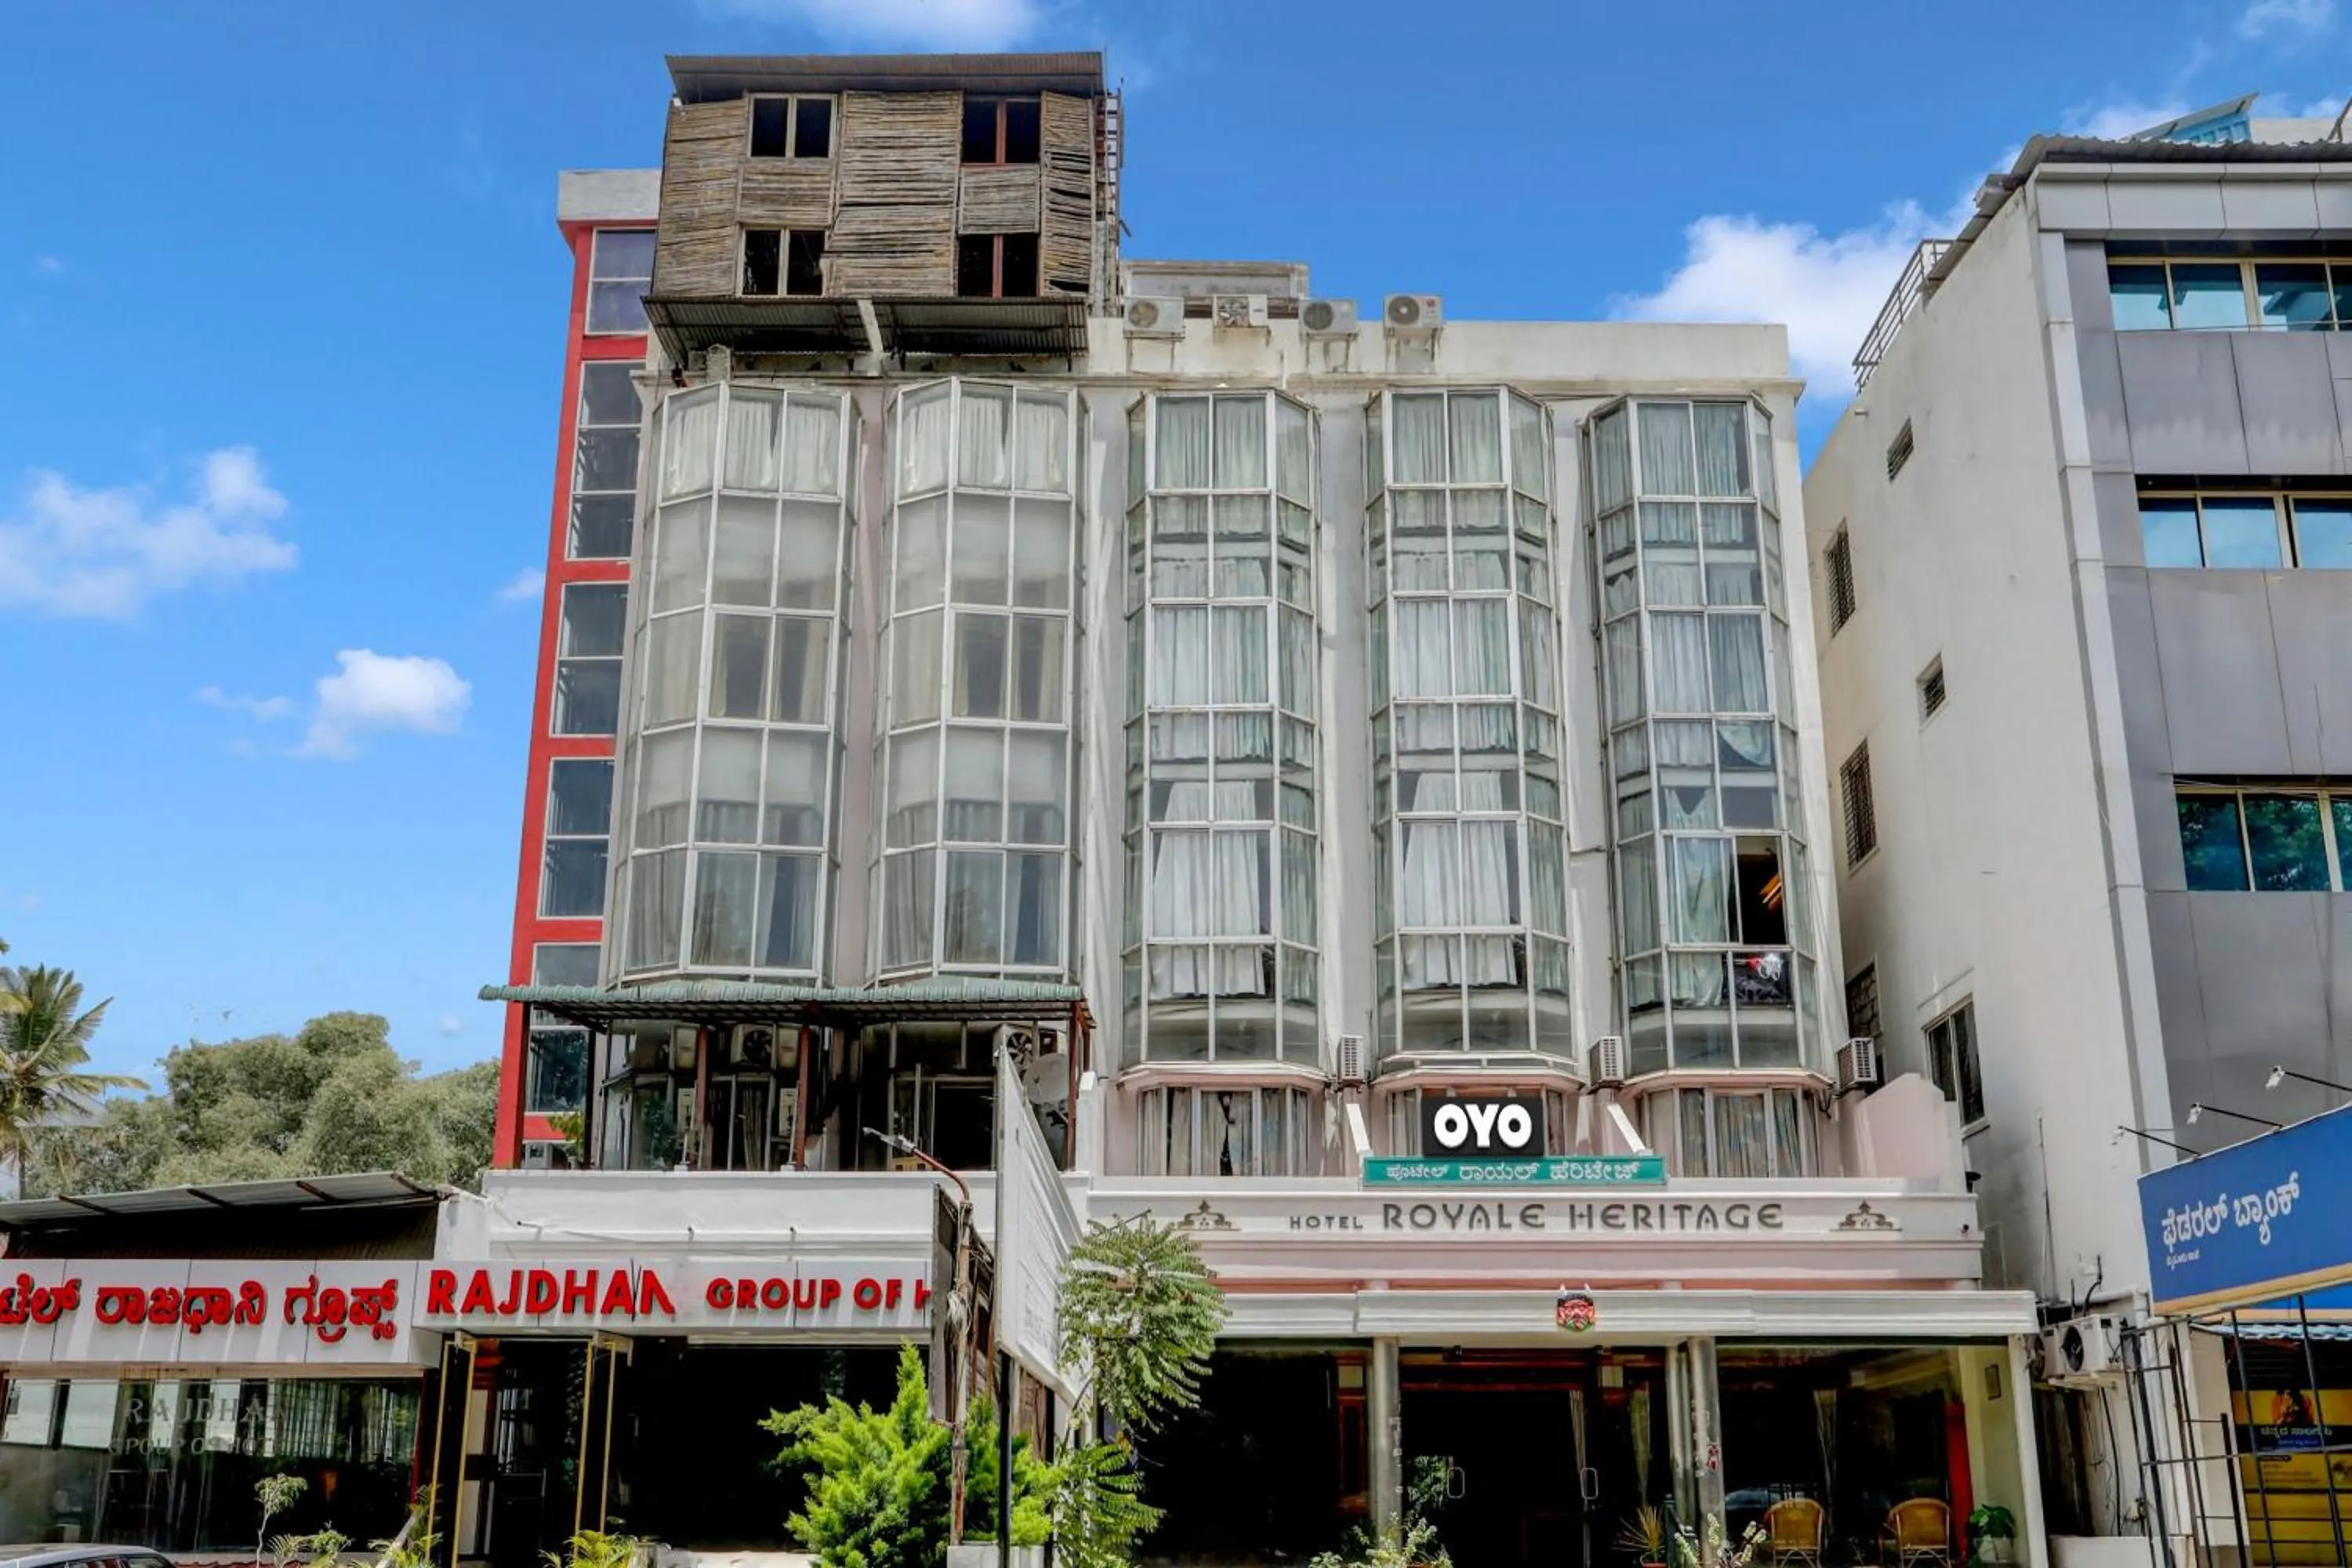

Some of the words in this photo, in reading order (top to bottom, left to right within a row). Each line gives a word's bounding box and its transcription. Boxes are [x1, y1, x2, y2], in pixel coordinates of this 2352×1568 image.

[1433, 1103, 1533, 1148] OYO
[1459, 1161, 1540, 1181] ರಾಯಲ್
[1289, 1215, 1364, 1230] HOTEL
[1382, 1203, 1547, 1229] ROYALE
[1569, 1203, 1784, 1229] HERITAGE
[2161, 1192, 2229, 1254] ಫೆಡರಲ್
[2233, 1171, 2300, 1246] ಬ್ಯಾಂಕ್
[94, 1279, 267, 1334] ರಾಜಧಾನಿ
[706, 1277, 842, 1310] GROUP
[853, 1278, 903, 1310] OF
